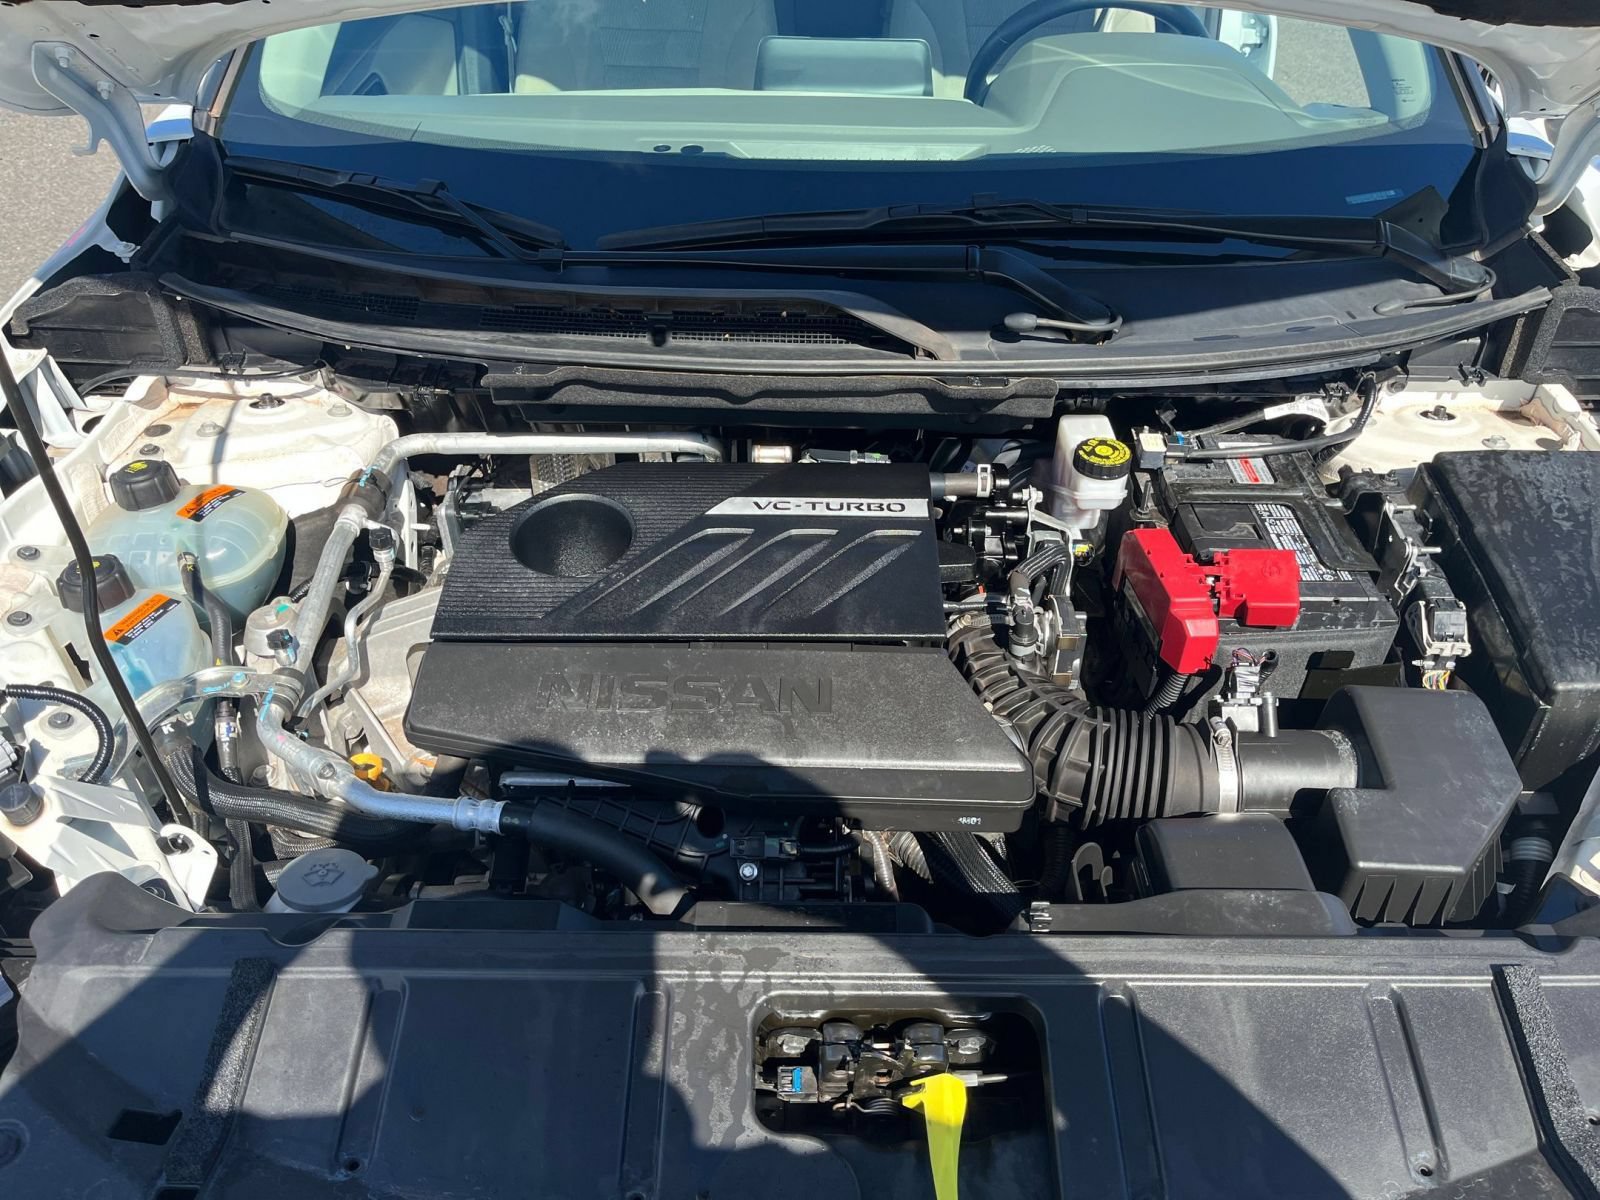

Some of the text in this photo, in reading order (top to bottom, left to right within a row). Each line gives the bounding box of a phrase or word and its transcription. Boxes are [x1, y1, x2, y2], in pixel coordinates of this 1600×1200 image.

[752, 501, 906, 513] VC-TURBO
[535, 672, 833, 715] NISSAN
[161, 723, 175, 735] K
